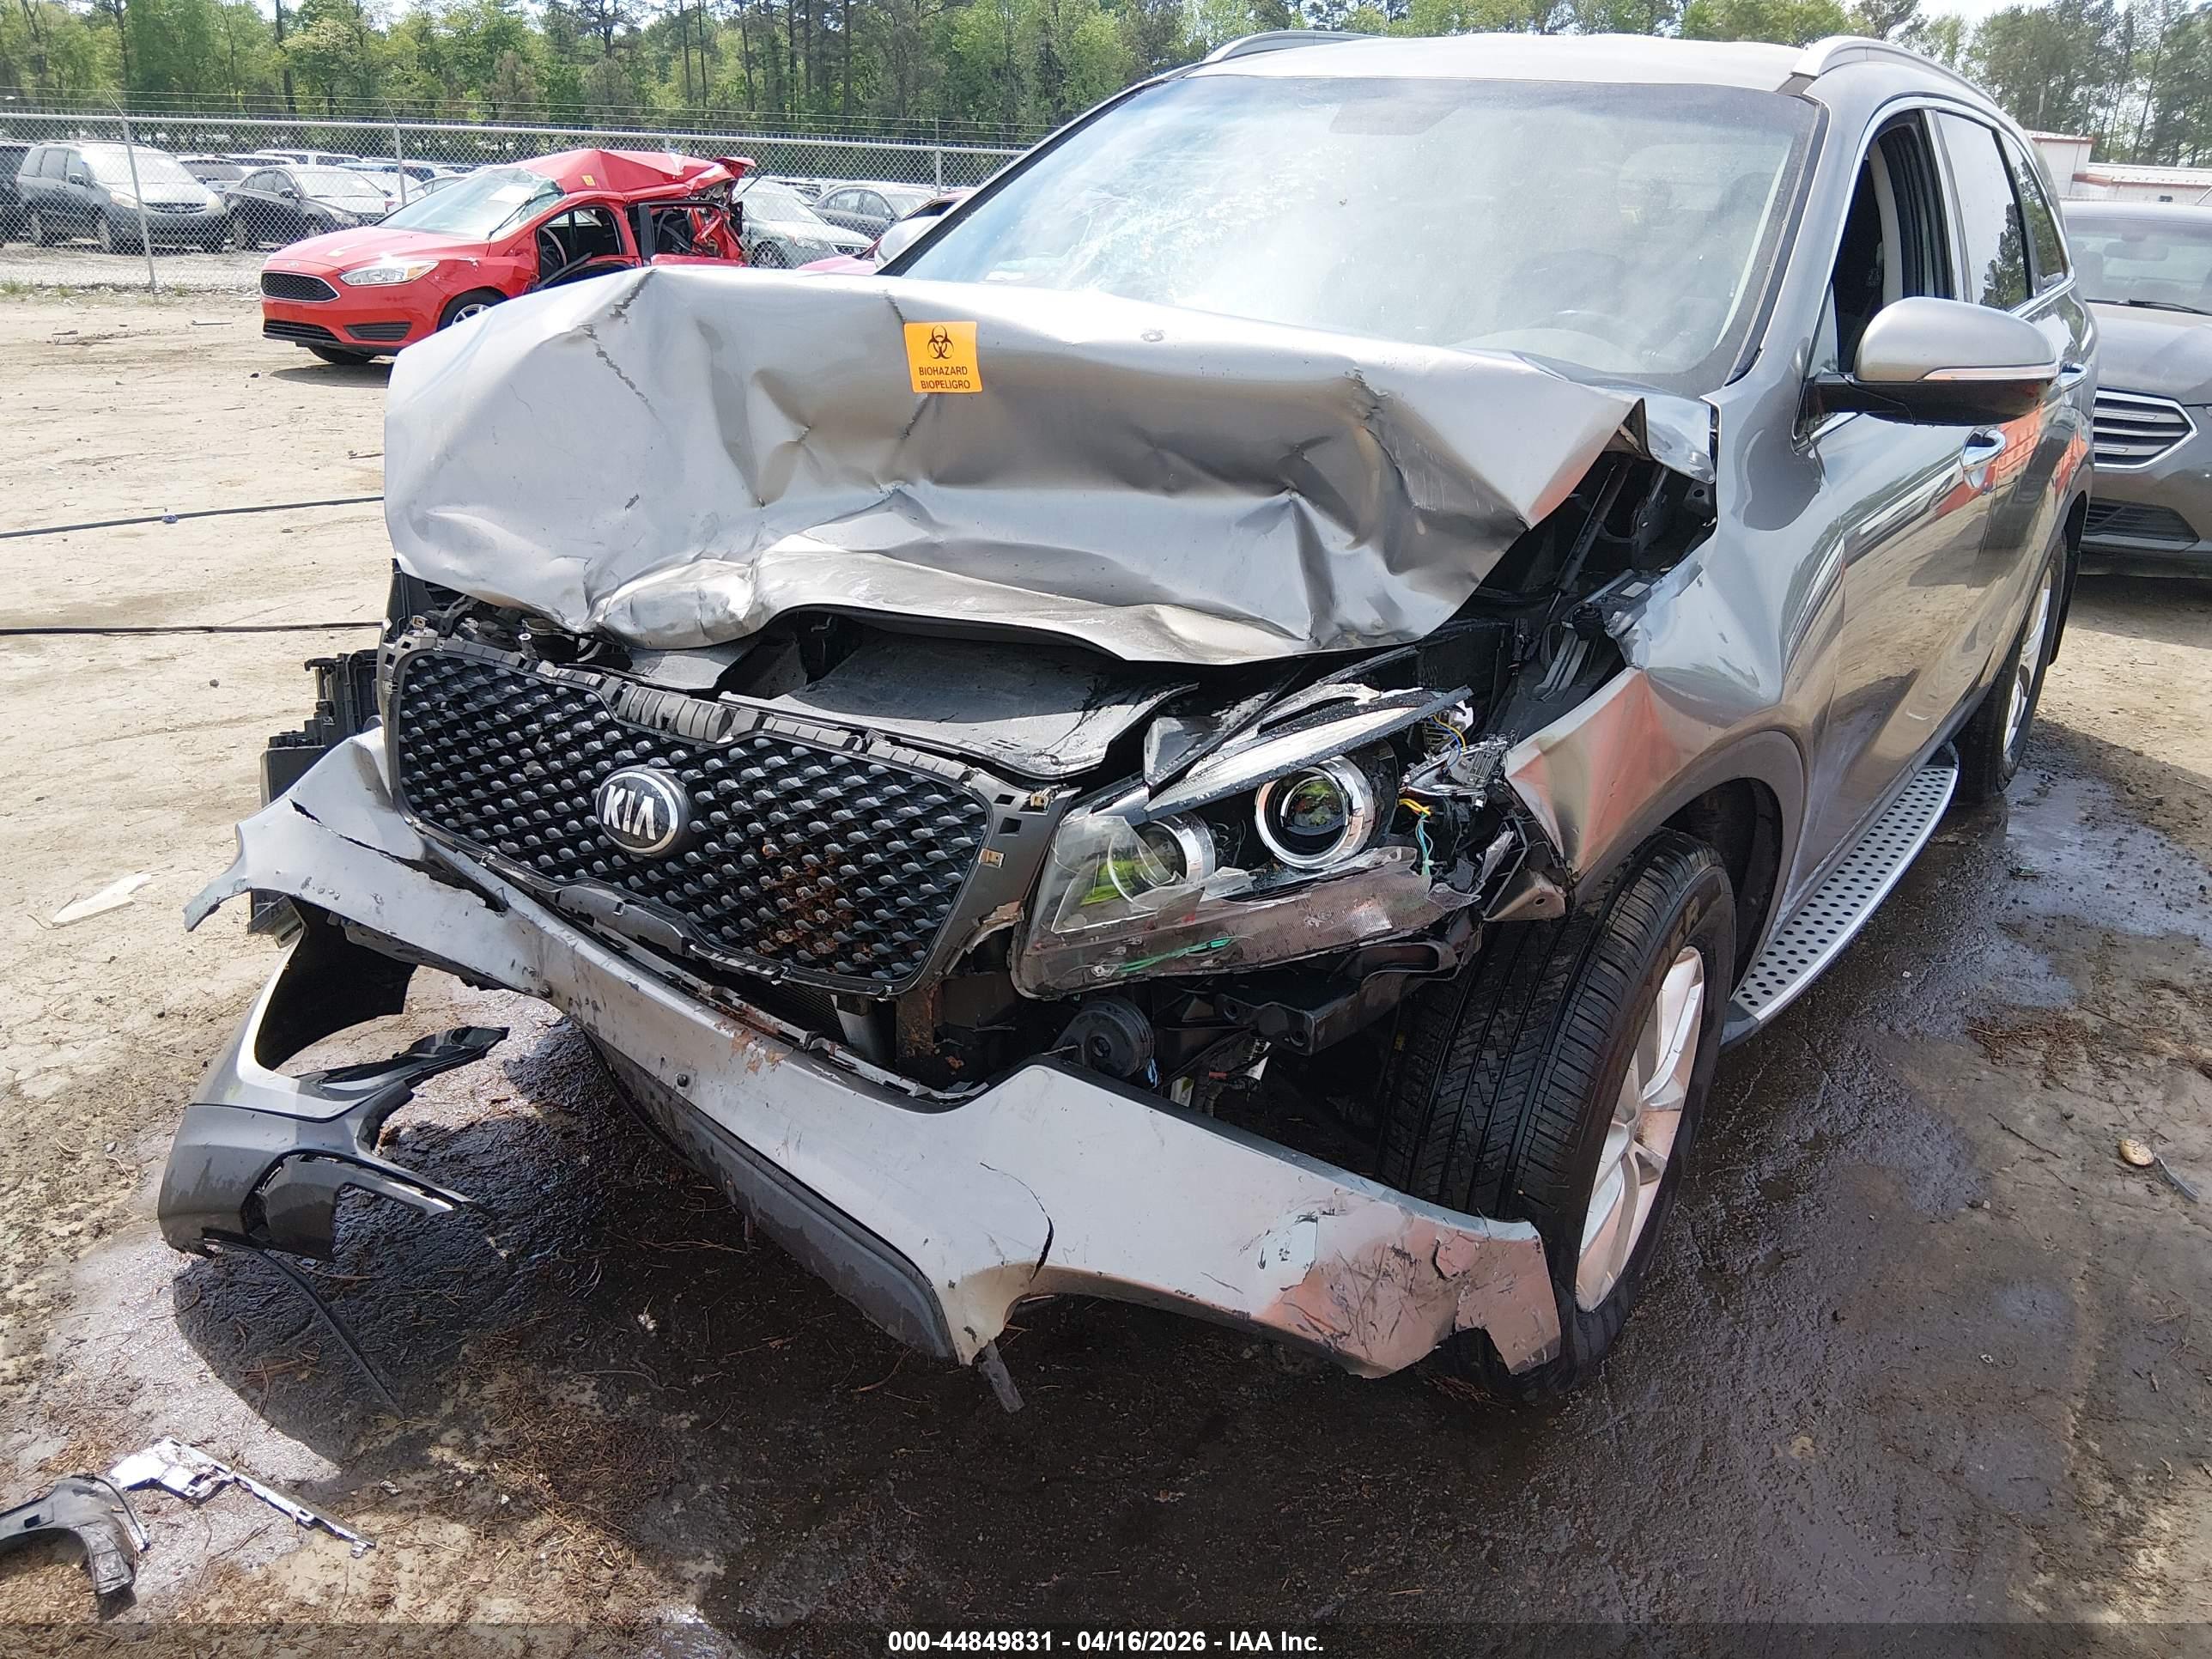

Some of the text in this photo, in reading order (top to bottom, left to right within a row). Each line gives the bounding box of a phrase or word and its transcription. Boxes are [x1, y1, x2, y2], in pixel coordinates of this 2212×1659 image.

[919, 367, 968, 376] BIOHAZARD
[921, 380, 970, 389] BIOPELIGRO
[603, 784, 657, 841] KIA
